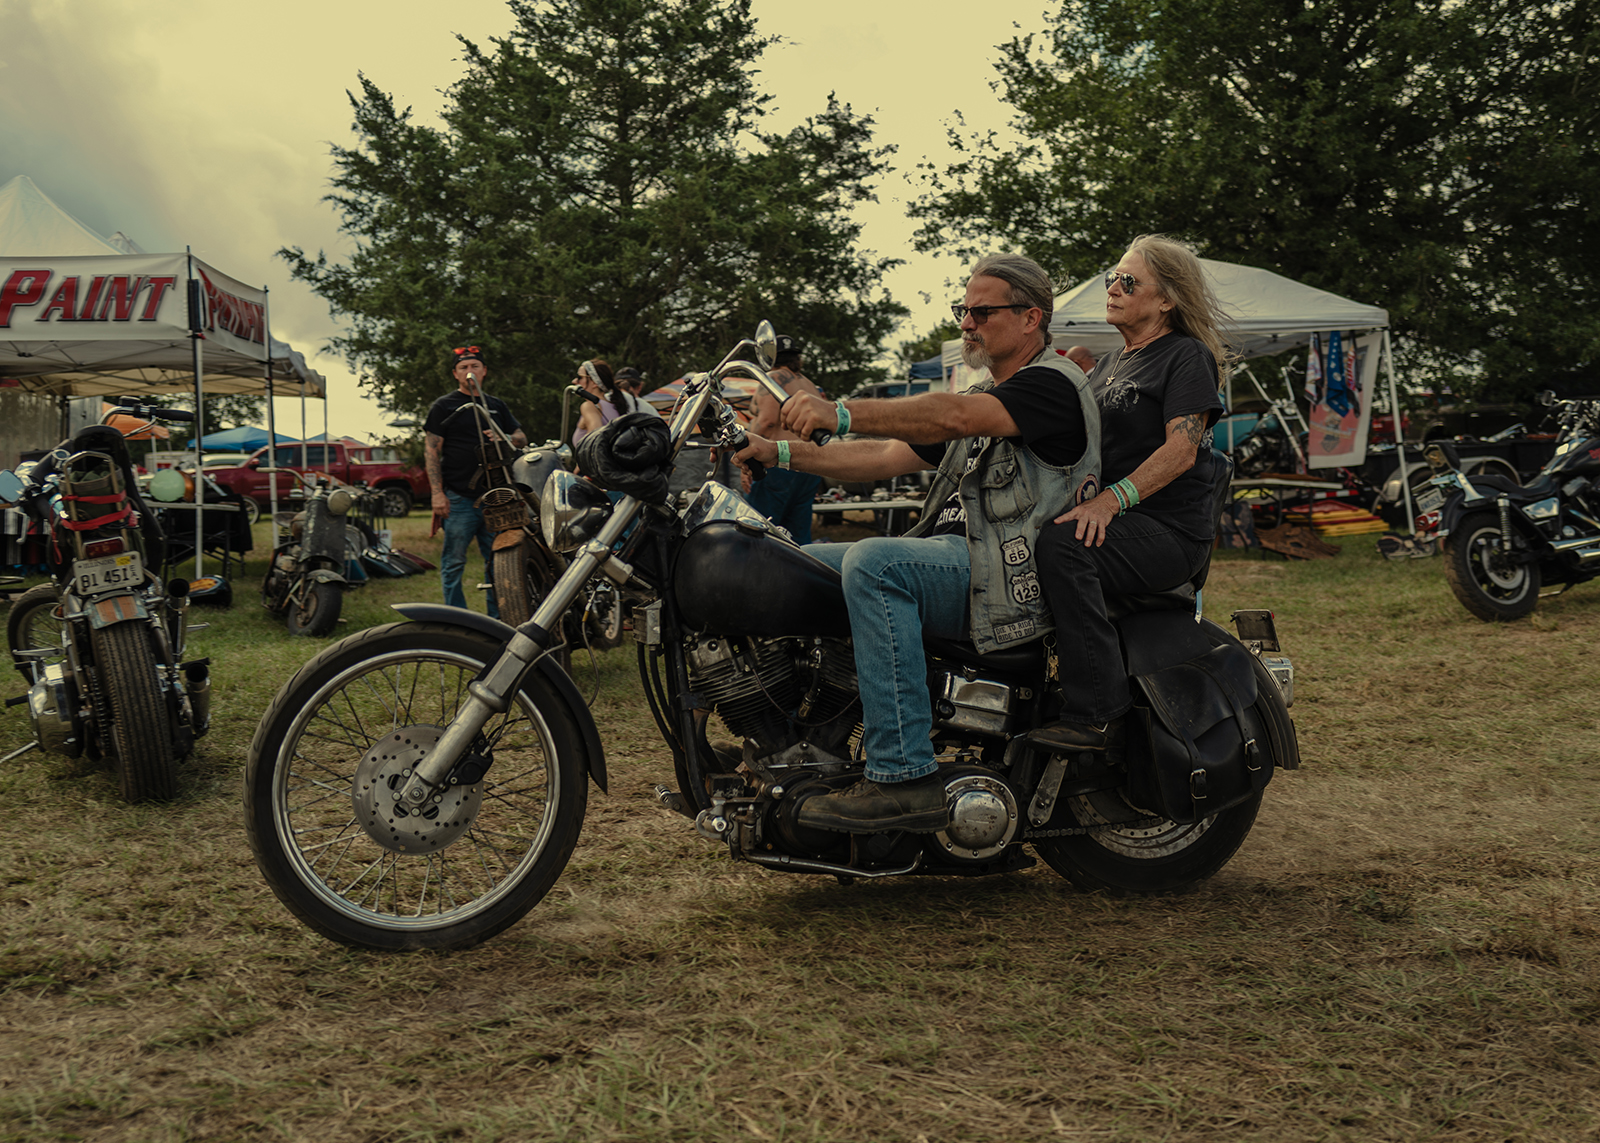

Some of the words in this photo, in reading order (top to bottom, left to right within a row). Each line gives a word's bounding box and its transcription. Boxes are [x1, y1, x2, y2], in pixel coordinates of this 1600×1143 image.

[0, 269, 178, 328] PAINT
[1009, 550, 1026, 563] 66
[1016, 585, 1039, 601] 129
[996, 627, 1006, 635] DIE
[1017, 620, 1032, 629] RIDE
[997, 633, 1013, 642] RIDE
[1024, 627, 1034, 636] DIE
